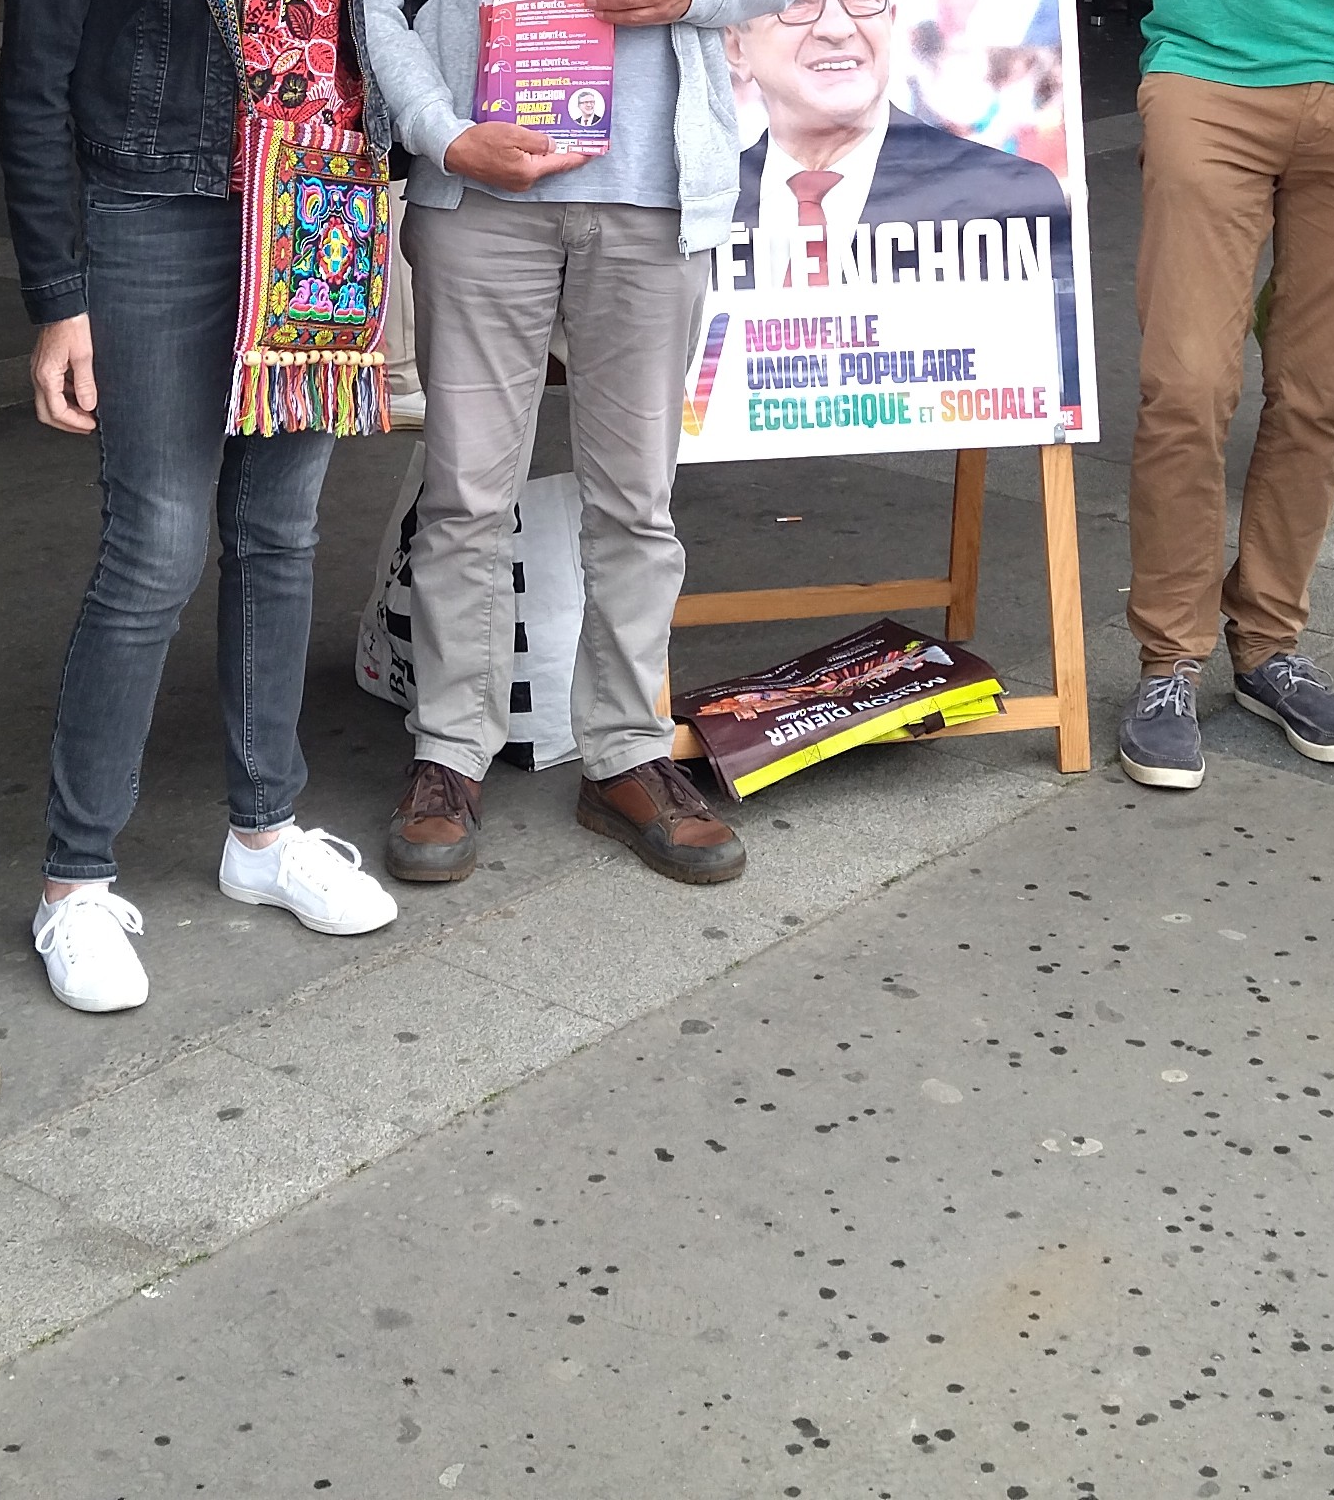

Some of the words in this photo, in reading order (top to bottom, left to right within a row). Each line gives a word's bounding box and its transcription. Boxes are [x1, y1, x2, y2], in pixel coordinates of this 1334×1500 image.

[516, 114, 557, 126] MINISTRE
[711, 215, 1053, 292] ÉLENCHON
[744, 314, 880, 353] NOUVELLE
[746, 354, 829, 390] UNION
[839, 348, 977, 387] POPULAIRE
[749, 391, 912, 432] ÉCOLOGIQUE
[919, 406, 935, 423] ET
[941, 386, 1048, 423] SOCIALE
[857, 676, 948, 713] MAISON
[764, 706, 854, 748] DIENER
